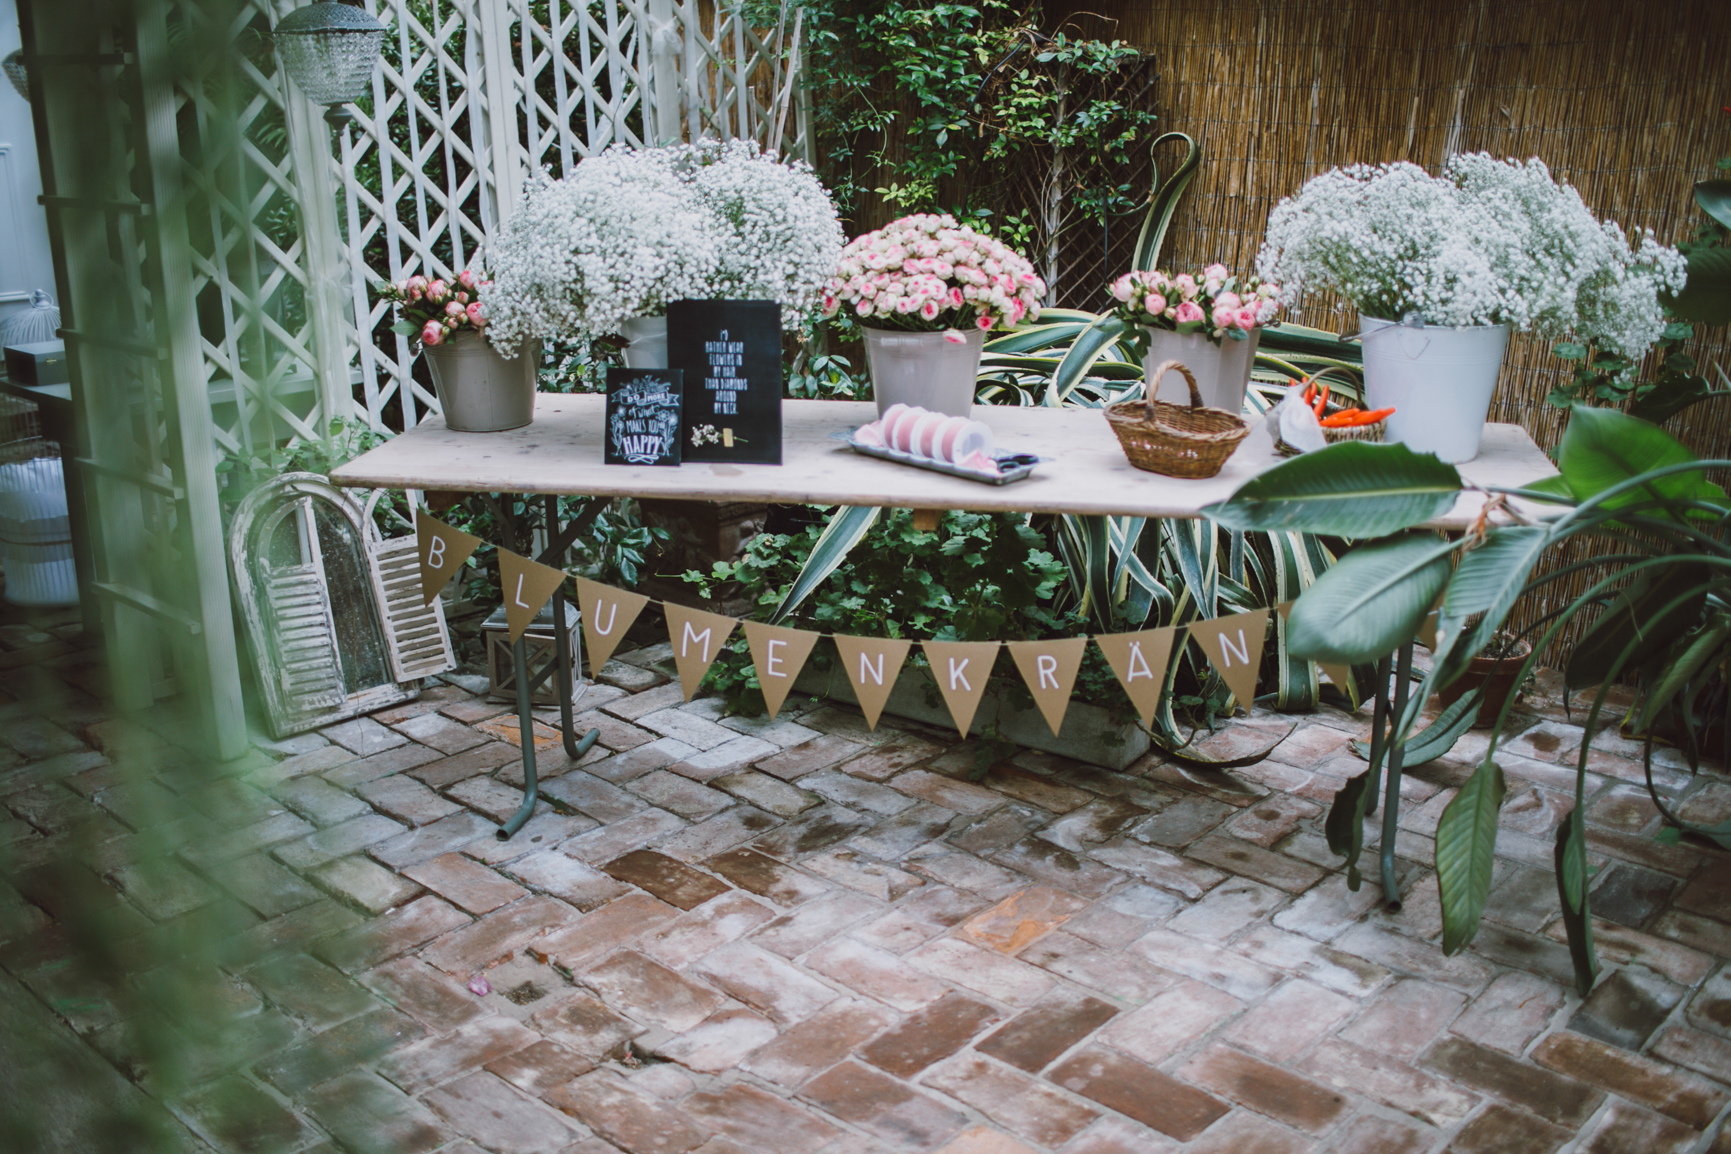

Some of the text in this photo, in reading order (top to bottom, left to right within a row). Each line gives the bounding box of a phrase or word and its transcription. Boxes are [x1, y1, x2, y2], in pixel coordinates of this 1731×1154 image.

[705, 341, 744, 354] RATHER WEAR
[709, 353, 735, 366] FLOWERS
[713, 366, 721, 378] MY
[705, 377, 748, 391] THAN DIAMONDS
[627, 393, 666, 403] DO MORE
[715, 390, 737, 402] AROUND
[714, 402, 721, 414] MY
[626, 419, 659, 434] MAKES YOU
[622, 434, 663, 455] HAPPY
